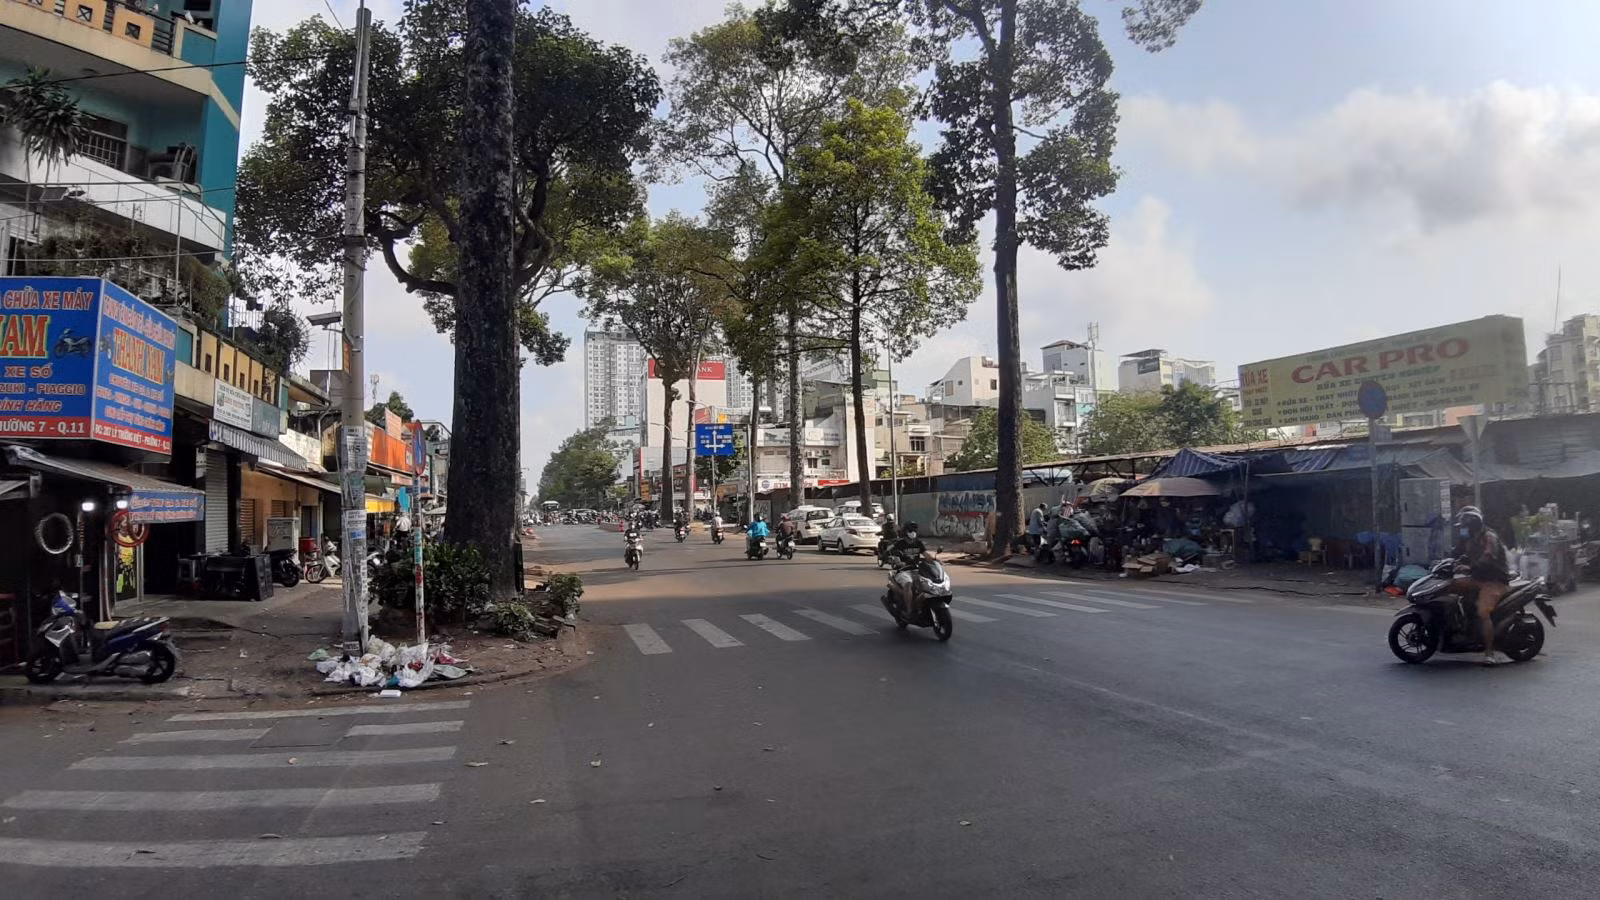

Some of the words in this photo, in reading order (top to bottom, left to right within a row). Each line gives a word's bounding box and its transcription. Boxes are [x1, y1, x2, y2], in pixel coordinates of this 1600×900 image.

[4, 285, 39, 310] CHỮA
[41, 291, 60, 310] XE
[62, 287, 94, 310] MÁY
[144, 340, 165, 385] NAM
[1291, 356, 1368, 384] CAR
[1378, 337, 1469, 370] PRO
[4, 366, 26, 378] XE
[30, 362, 53, 378] SỐ
[36, 383, 86, 395] PIAGGIO
[25, 398, 63, 412] HÃNG
[38, 421, 46, 433] 7
[57, 421, 85, 434] Q.11
